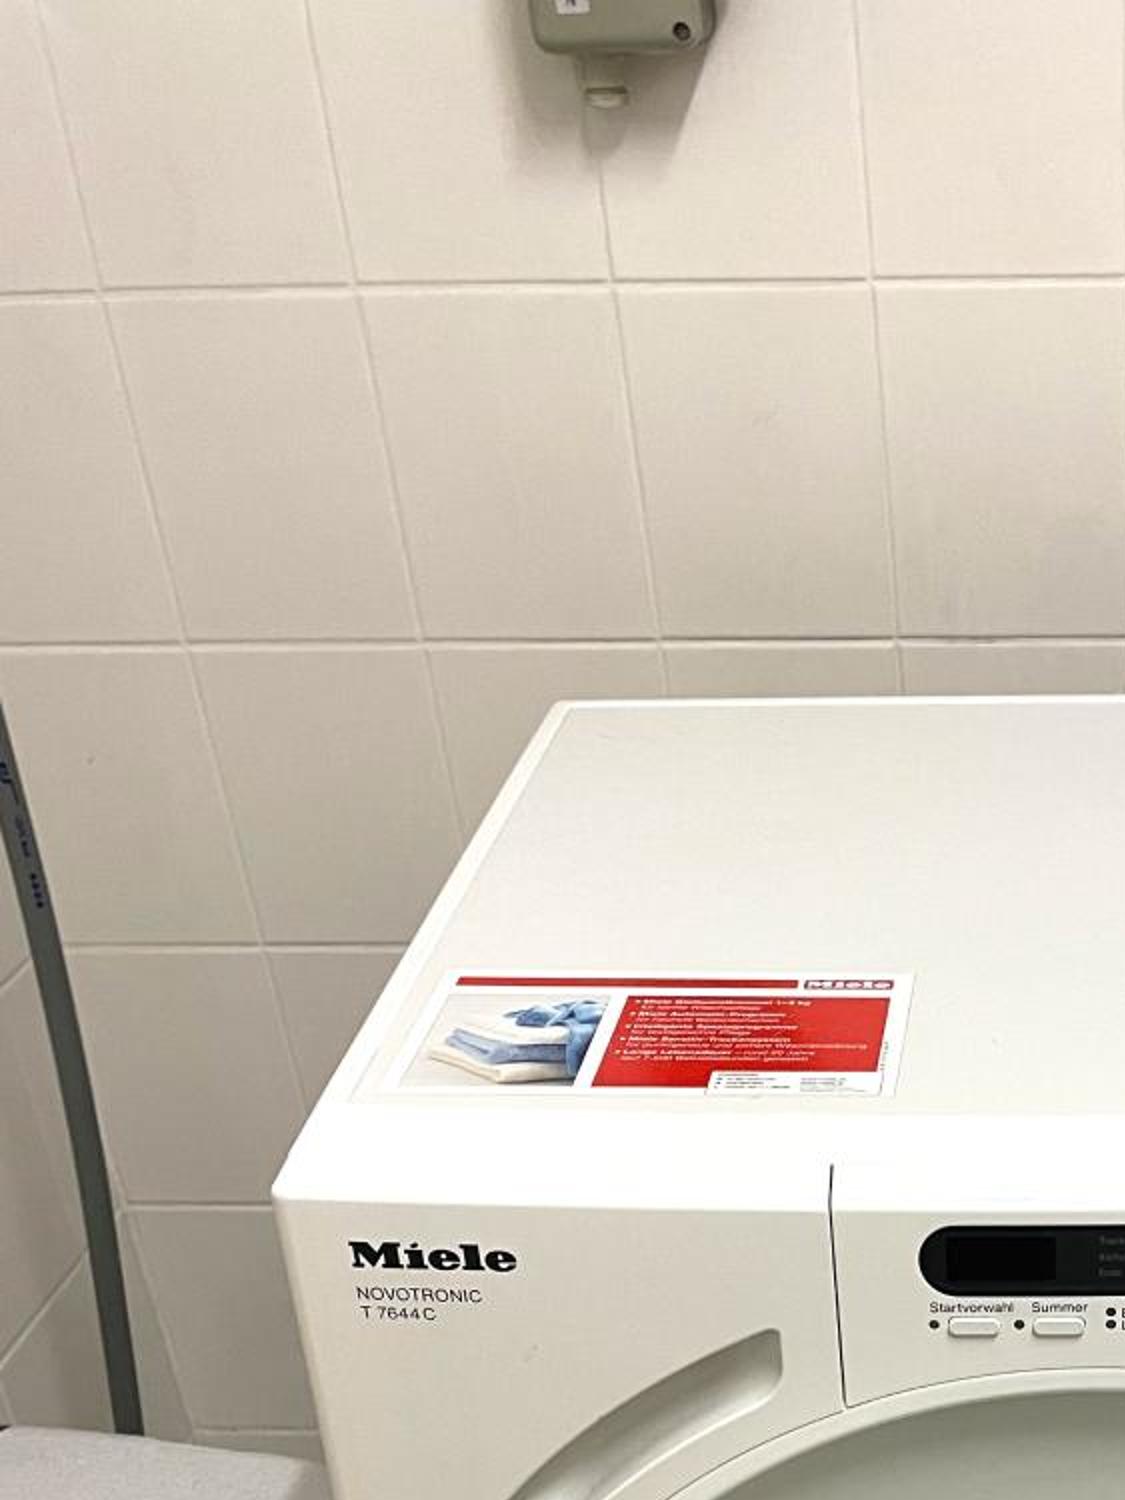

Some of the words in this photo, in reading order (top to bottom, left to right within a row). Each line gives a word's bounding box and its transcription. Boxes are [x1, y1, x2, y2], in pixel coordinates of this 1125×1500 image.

[348, 1241, 517, 1272] Miele
[356, 1287, 482, 1302] NOVOTRONIC
[360, 1306, 371, 1319] T
[930, 1302, 1014, 1313] Startvorwahl
[1032, 1302, 1088, 1312] Summer
